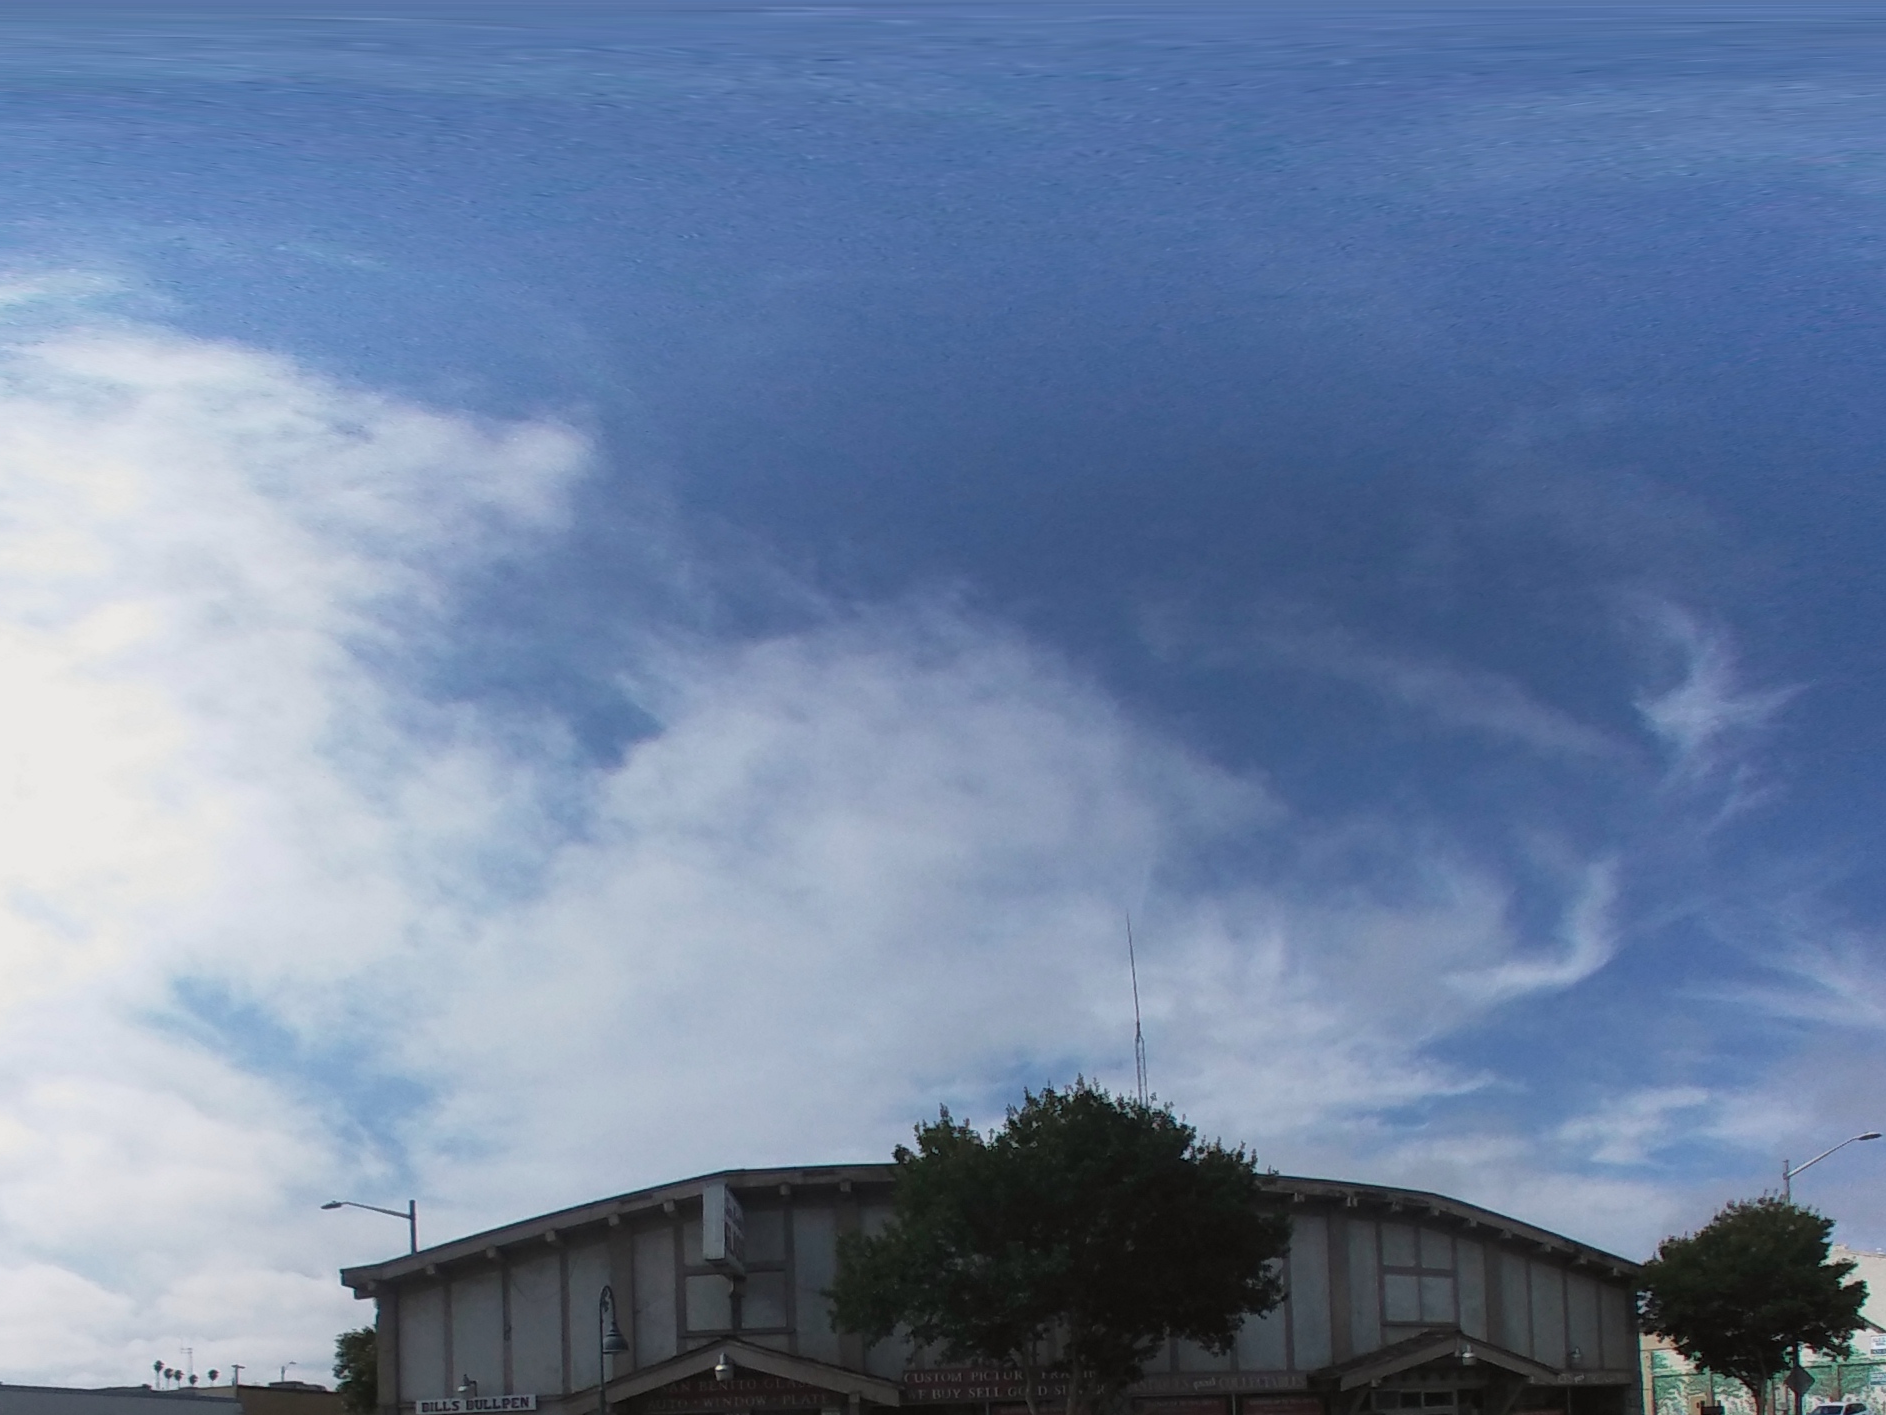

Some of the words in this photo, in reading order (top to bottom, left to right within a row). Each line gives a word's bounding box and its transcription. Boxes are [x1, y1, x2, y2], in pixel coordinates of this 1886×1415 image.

[903, 1372, 963, 1384] CUSTOM
[971, 1370, 1024, 1382] PICTUR
[699, 1378, 757, 1393] BENITO
[931, 1387, 961, 1399] BUY
[968, 1385, 1002, 1398] SELL
[1007, 1385, 1048, 1397] GOD
[465, 1396, 530, 1411] BULLPEN
[647, 1399, 688, 1411] AUTO
[703, 1393, 767, 1408] WINDOW
